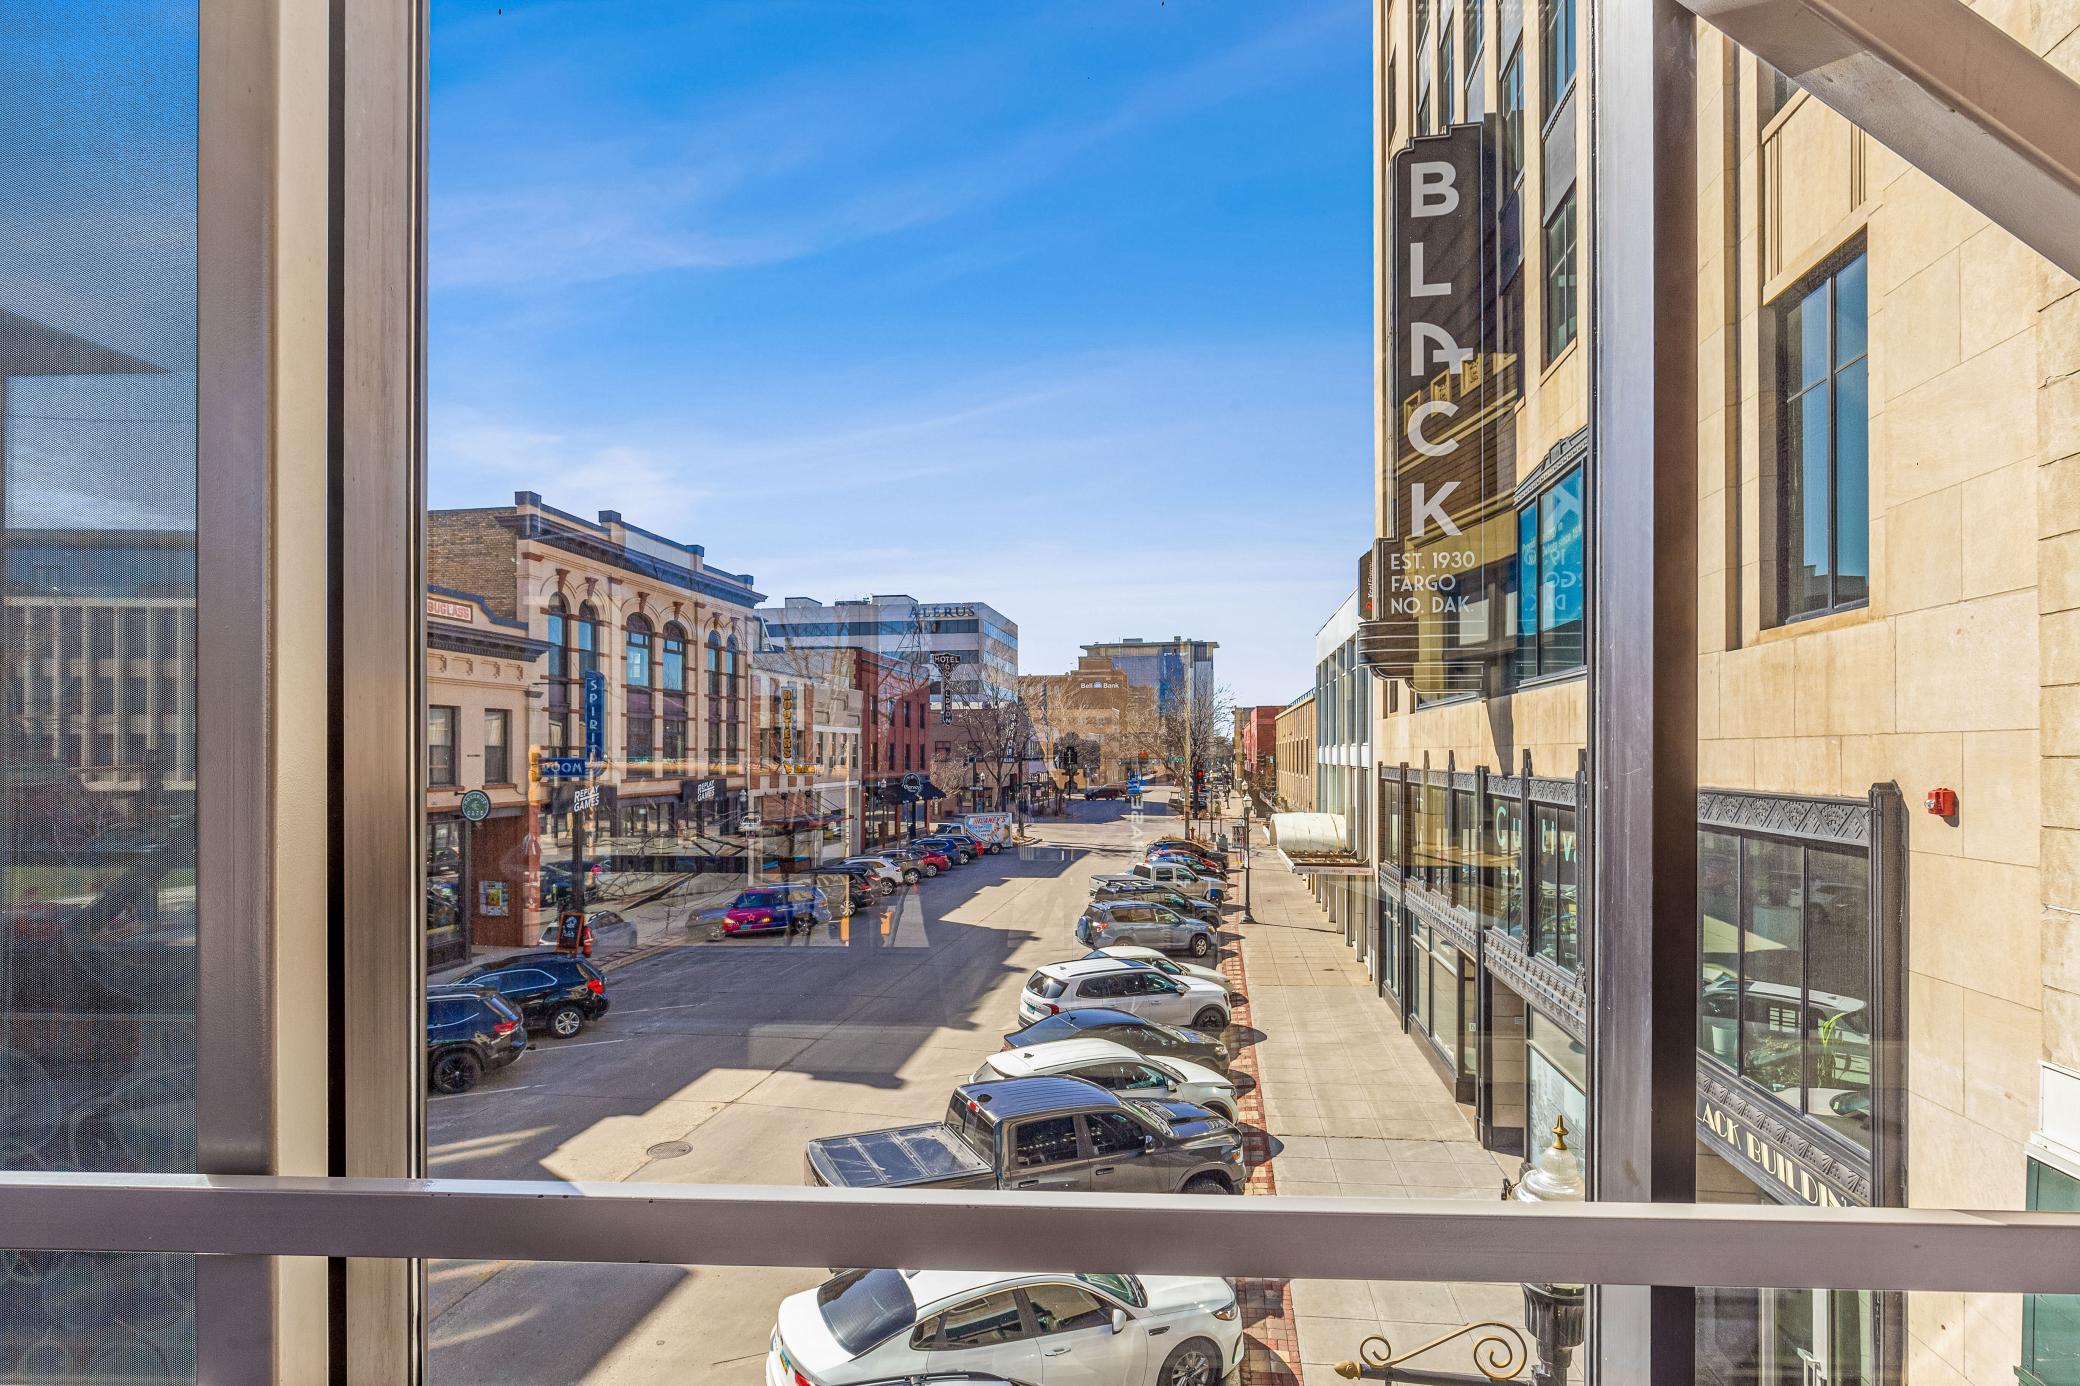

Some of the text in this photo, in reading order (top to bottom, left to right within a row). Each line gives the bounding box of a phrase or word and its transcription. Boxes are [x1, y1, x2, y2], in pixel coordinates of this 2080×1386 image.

[1407, 160, 1474, 538] BLACK
[1391, 550, 1476, 570] EST. 1930
[1391, 573, 1456, 592] FARGO
[908, 605, 975, 618] ALERUS
[1391, 595, 1475, 615] NO. DAK.
[934, 654, 960, 663] HOTEL
[943, 663, 952, 723] DONALDSON
[589, 680, 598, 754] SPIRIT
[542, 762, 583, 774] ROOM
[574, 785, 600, 803] REPLAY
[574, 796, 600, 812] GAMES
[1746, 1131, 1857, 1208] BUILDIN
